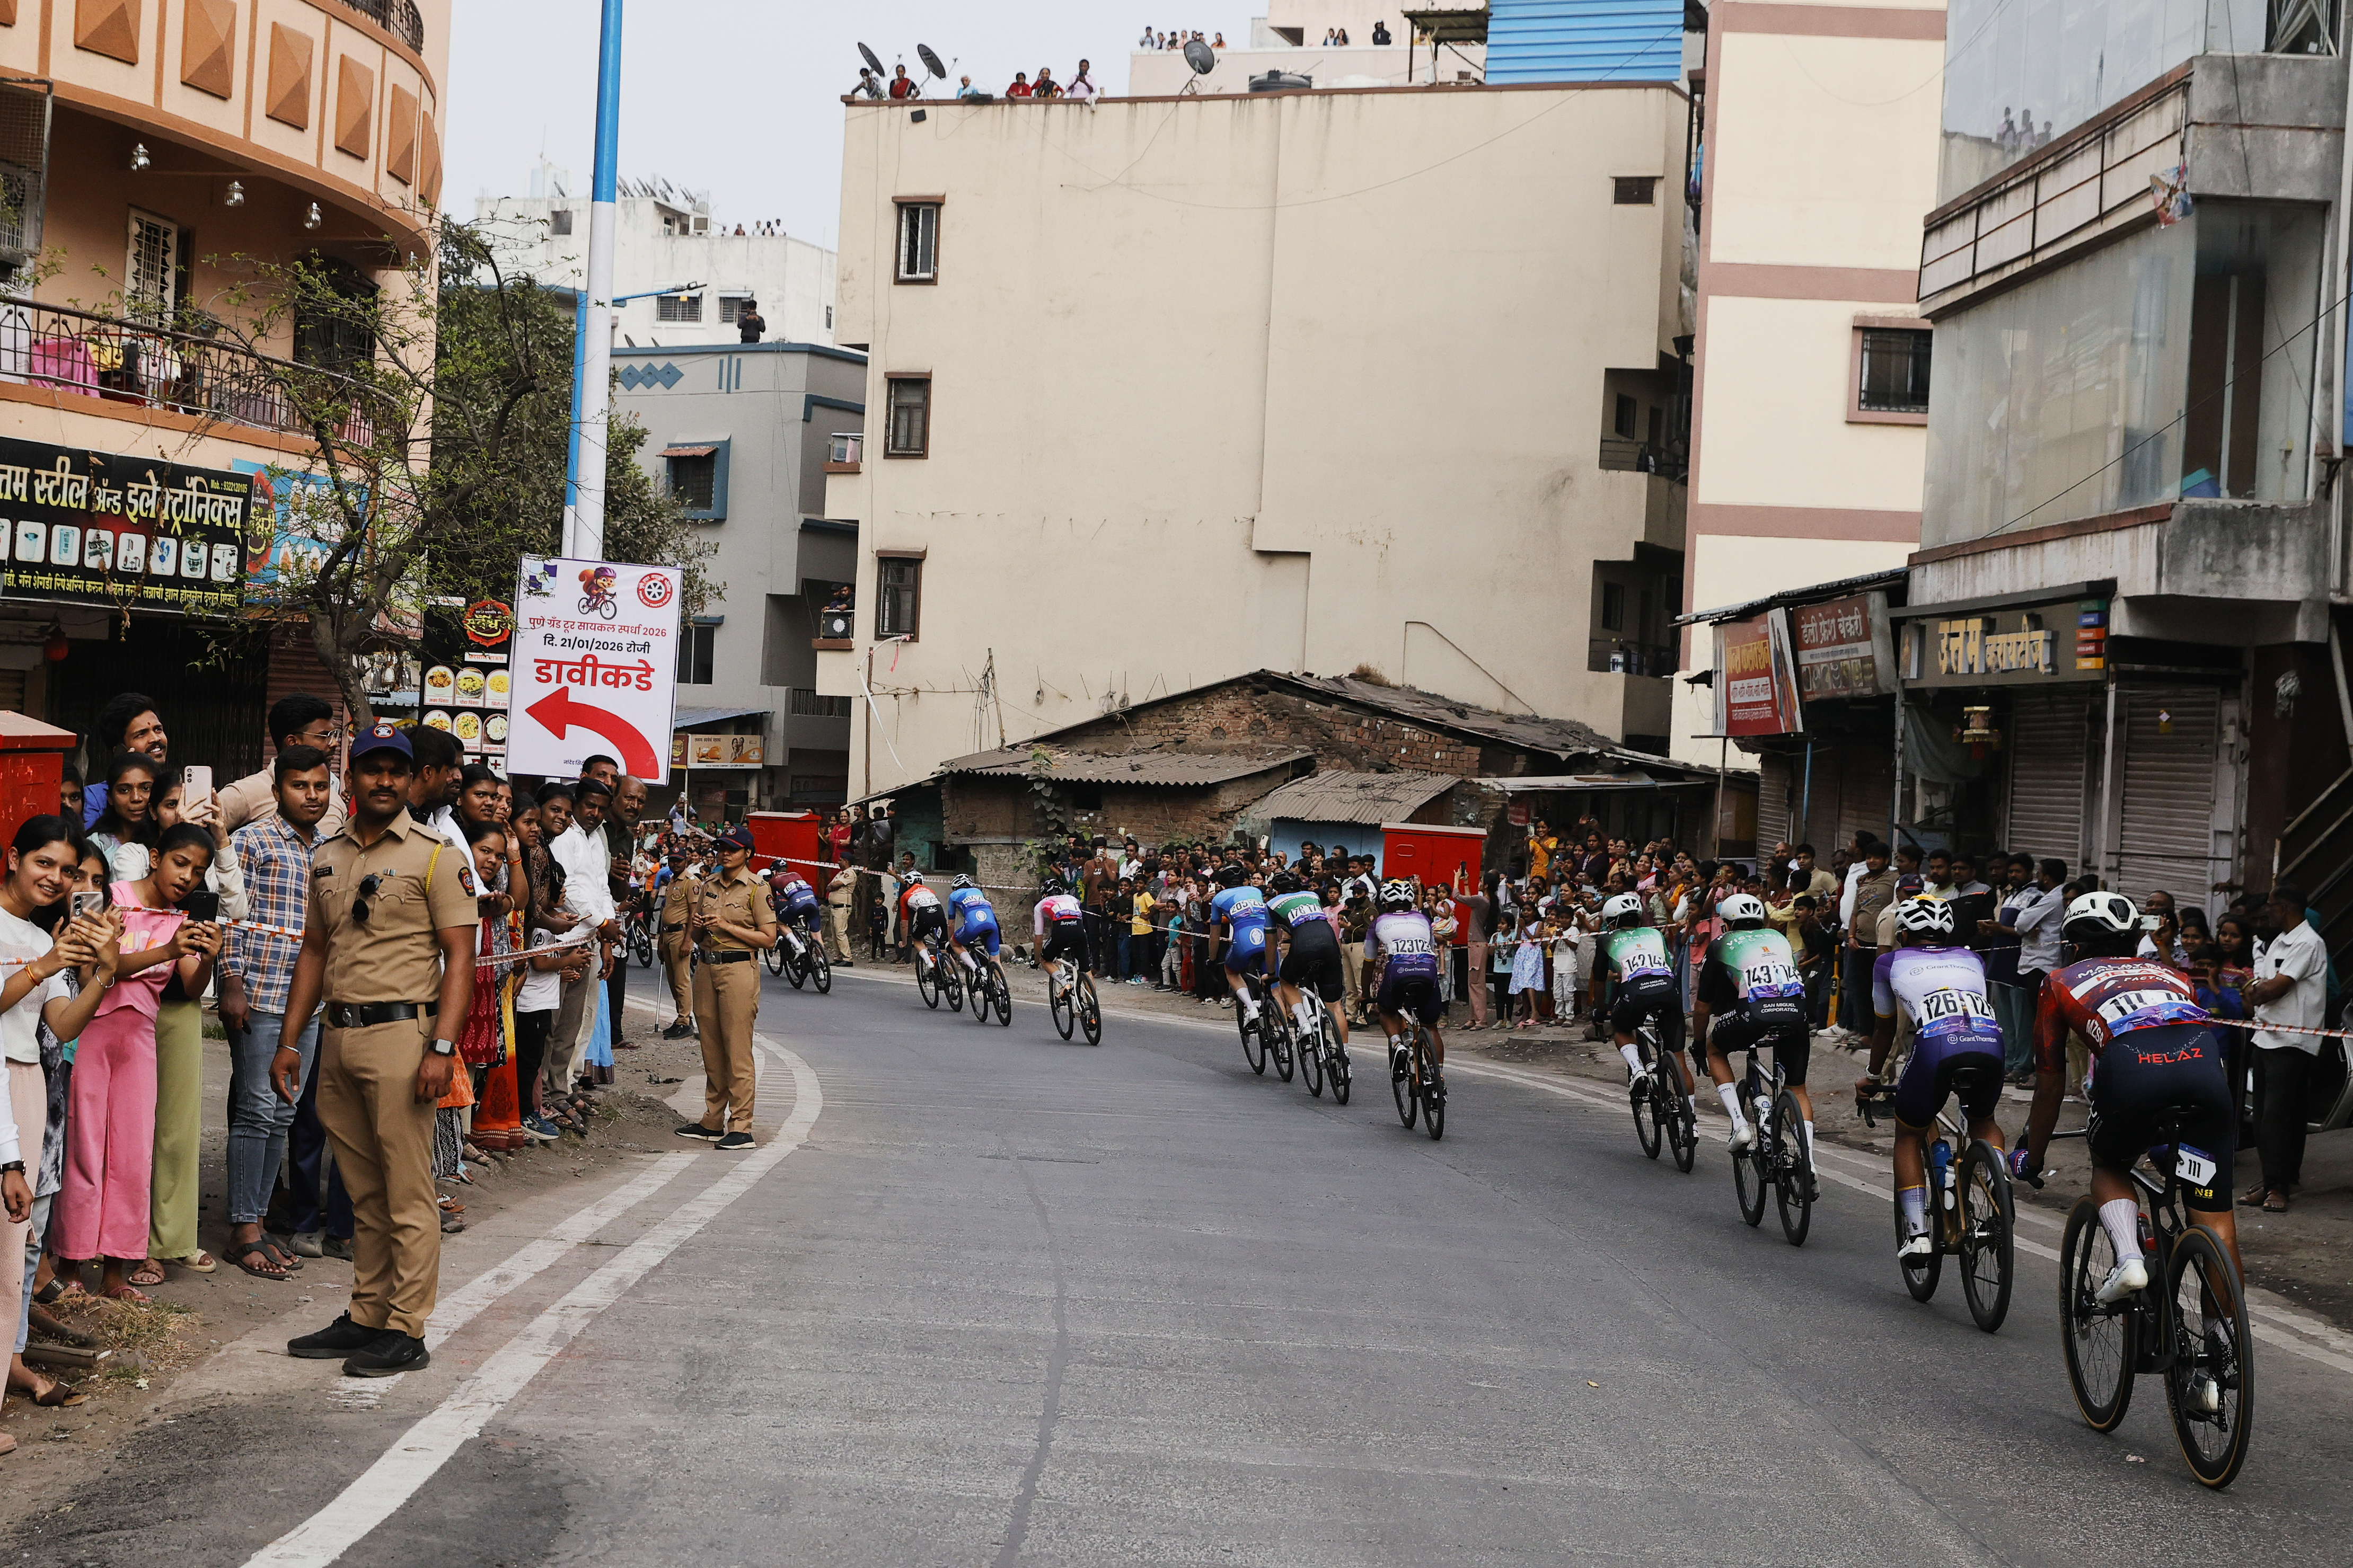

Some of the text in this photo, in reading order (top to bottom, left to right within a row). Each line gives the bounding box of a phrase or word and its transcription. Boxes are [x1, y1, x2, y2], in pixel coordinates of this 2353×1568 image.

[34, 456, 90, 509] स्टील
[528, 616, 666, 637] पुणे ग्रँड टूर सायकल स्पर्धा 2026
[543, 633, 651, 654] दि. 21/01/2026 रोजी
[534, 654, 655, 692] डावीकडे
[1290, 906, 1306, 919] 176
[2069, 909, 2090, 918] LAZER
[1394, 939, 1414, 953] 123
[1639, 981, 1667, 990] CORPORATION
[1745, 965, 1772, 987] 143
[2123, 976, 2170, 984] FACTOR
[1923, 993, 1959, 1020] 126
[2138, 1048, 2204, 1064] HELAZ
[2016, 1150, 2029, 1174] MPC
[2188, 1158, 2201, 1178] 111
